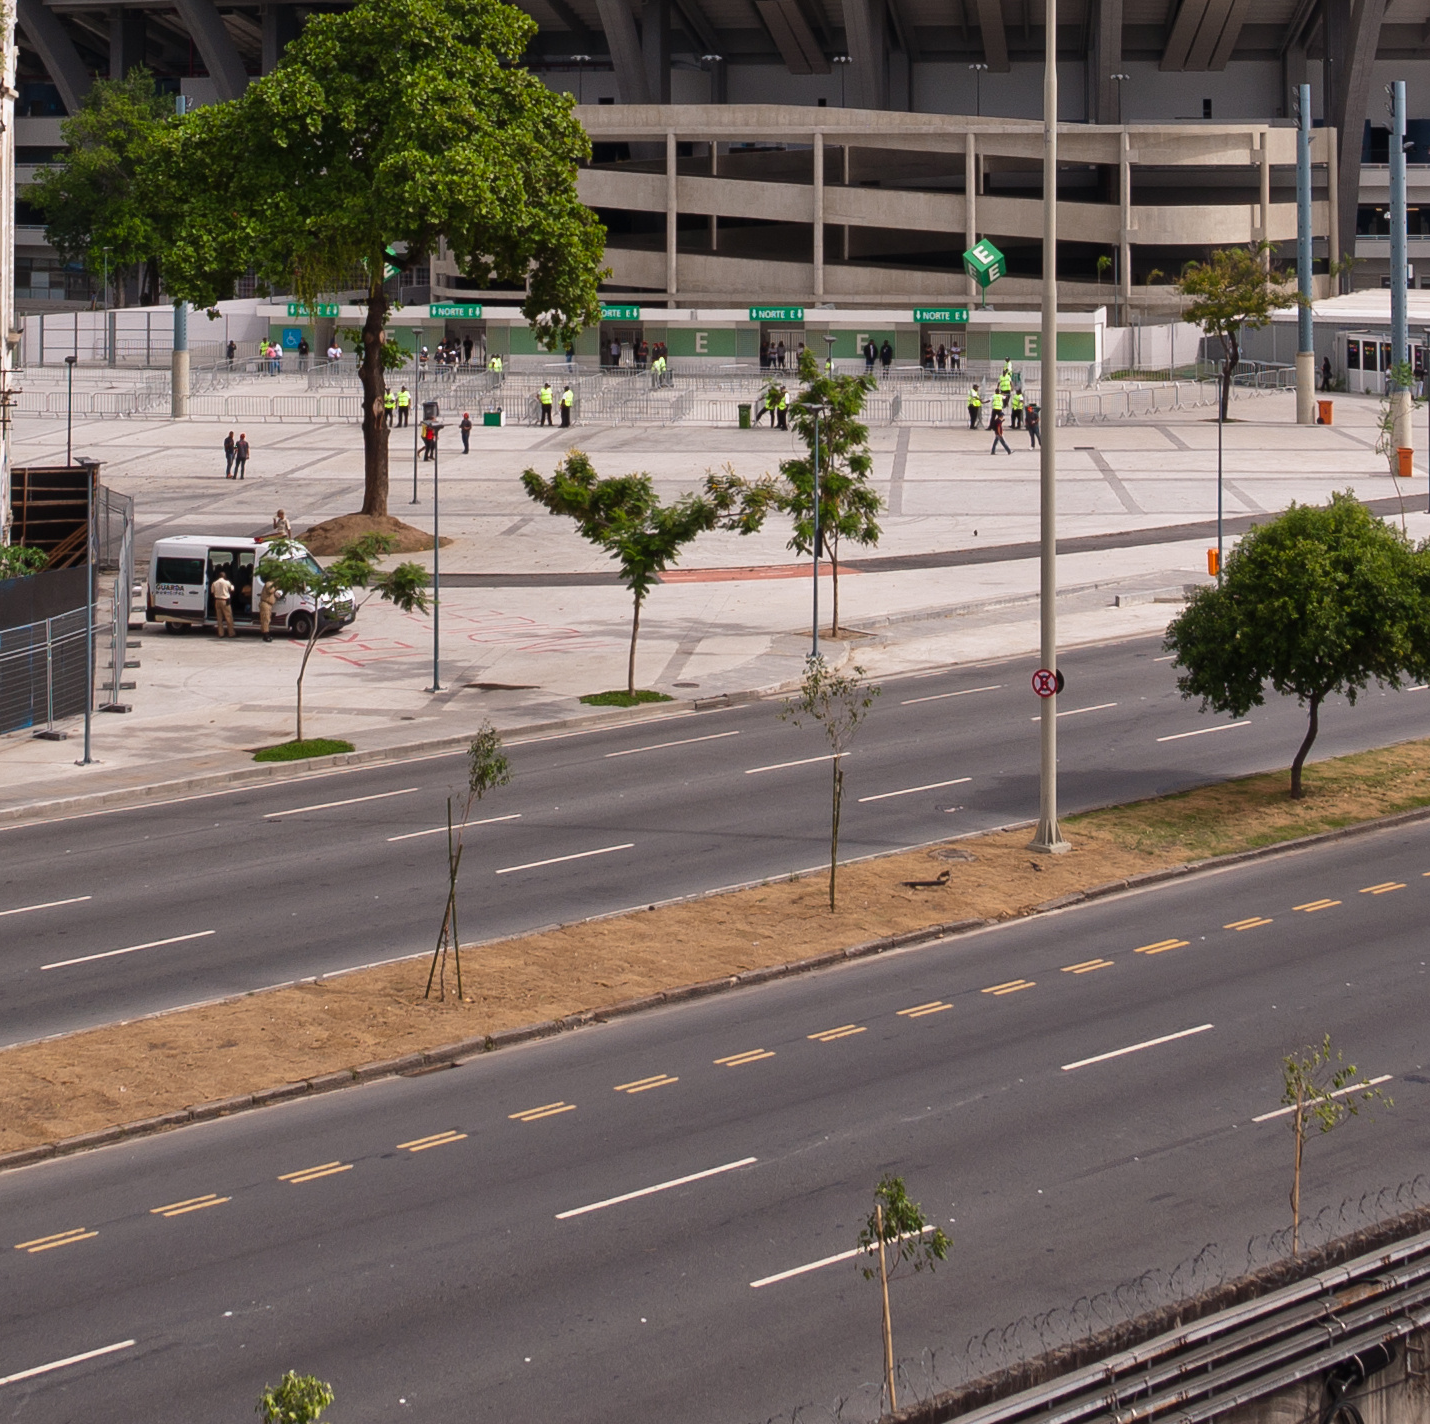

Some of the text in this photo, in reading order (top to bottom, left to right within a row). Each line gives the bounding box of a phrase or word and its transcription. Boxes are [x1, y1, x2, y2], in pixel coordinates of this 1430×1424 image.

[972, 245, 995, 265] E
[968, 263, 978, 281] E
[988, 263, 1001, 282] E
[438, 307, 474, 316] NORTE E
[601, 309, 631, 318] ORTE E
[758, 310, 795, 319] NORTE E
[922, 311, 960, 320] NORTE E
[695, 332, 708, 353] E
[856, 333, 869, 355] E
[1024, 335, 1038, 357] E
[155, 583, 185, 591] GUARDA
